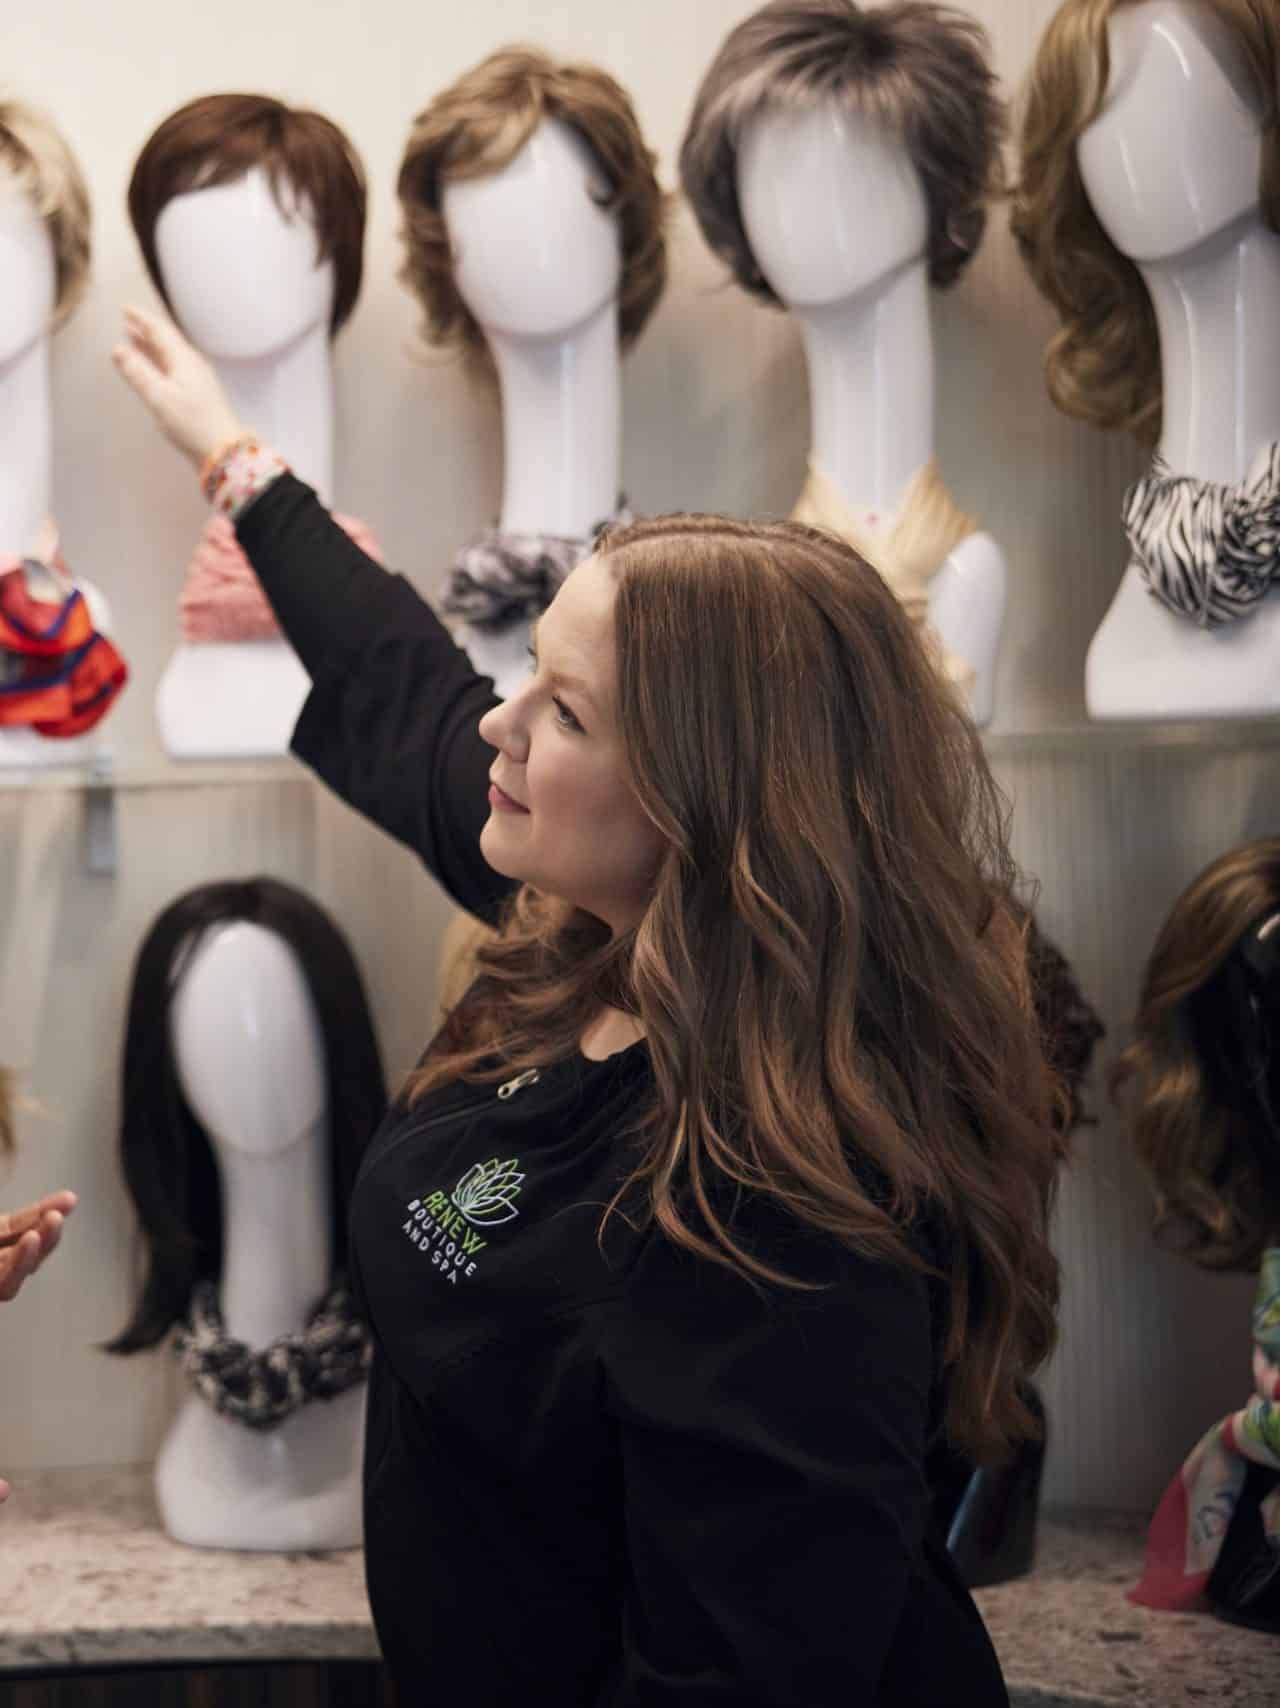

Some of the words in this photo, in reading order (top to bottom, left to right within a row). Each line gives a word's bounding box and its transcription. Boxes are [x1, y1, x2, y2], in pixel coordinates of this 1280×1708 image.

[402, 1220, 430, 1251] AND
[431, 1250, 457, 1285] SPA
[407, 1199, 478, 1277] BOUTIQUE
[423, 1189, 488, 1255] RENEW
